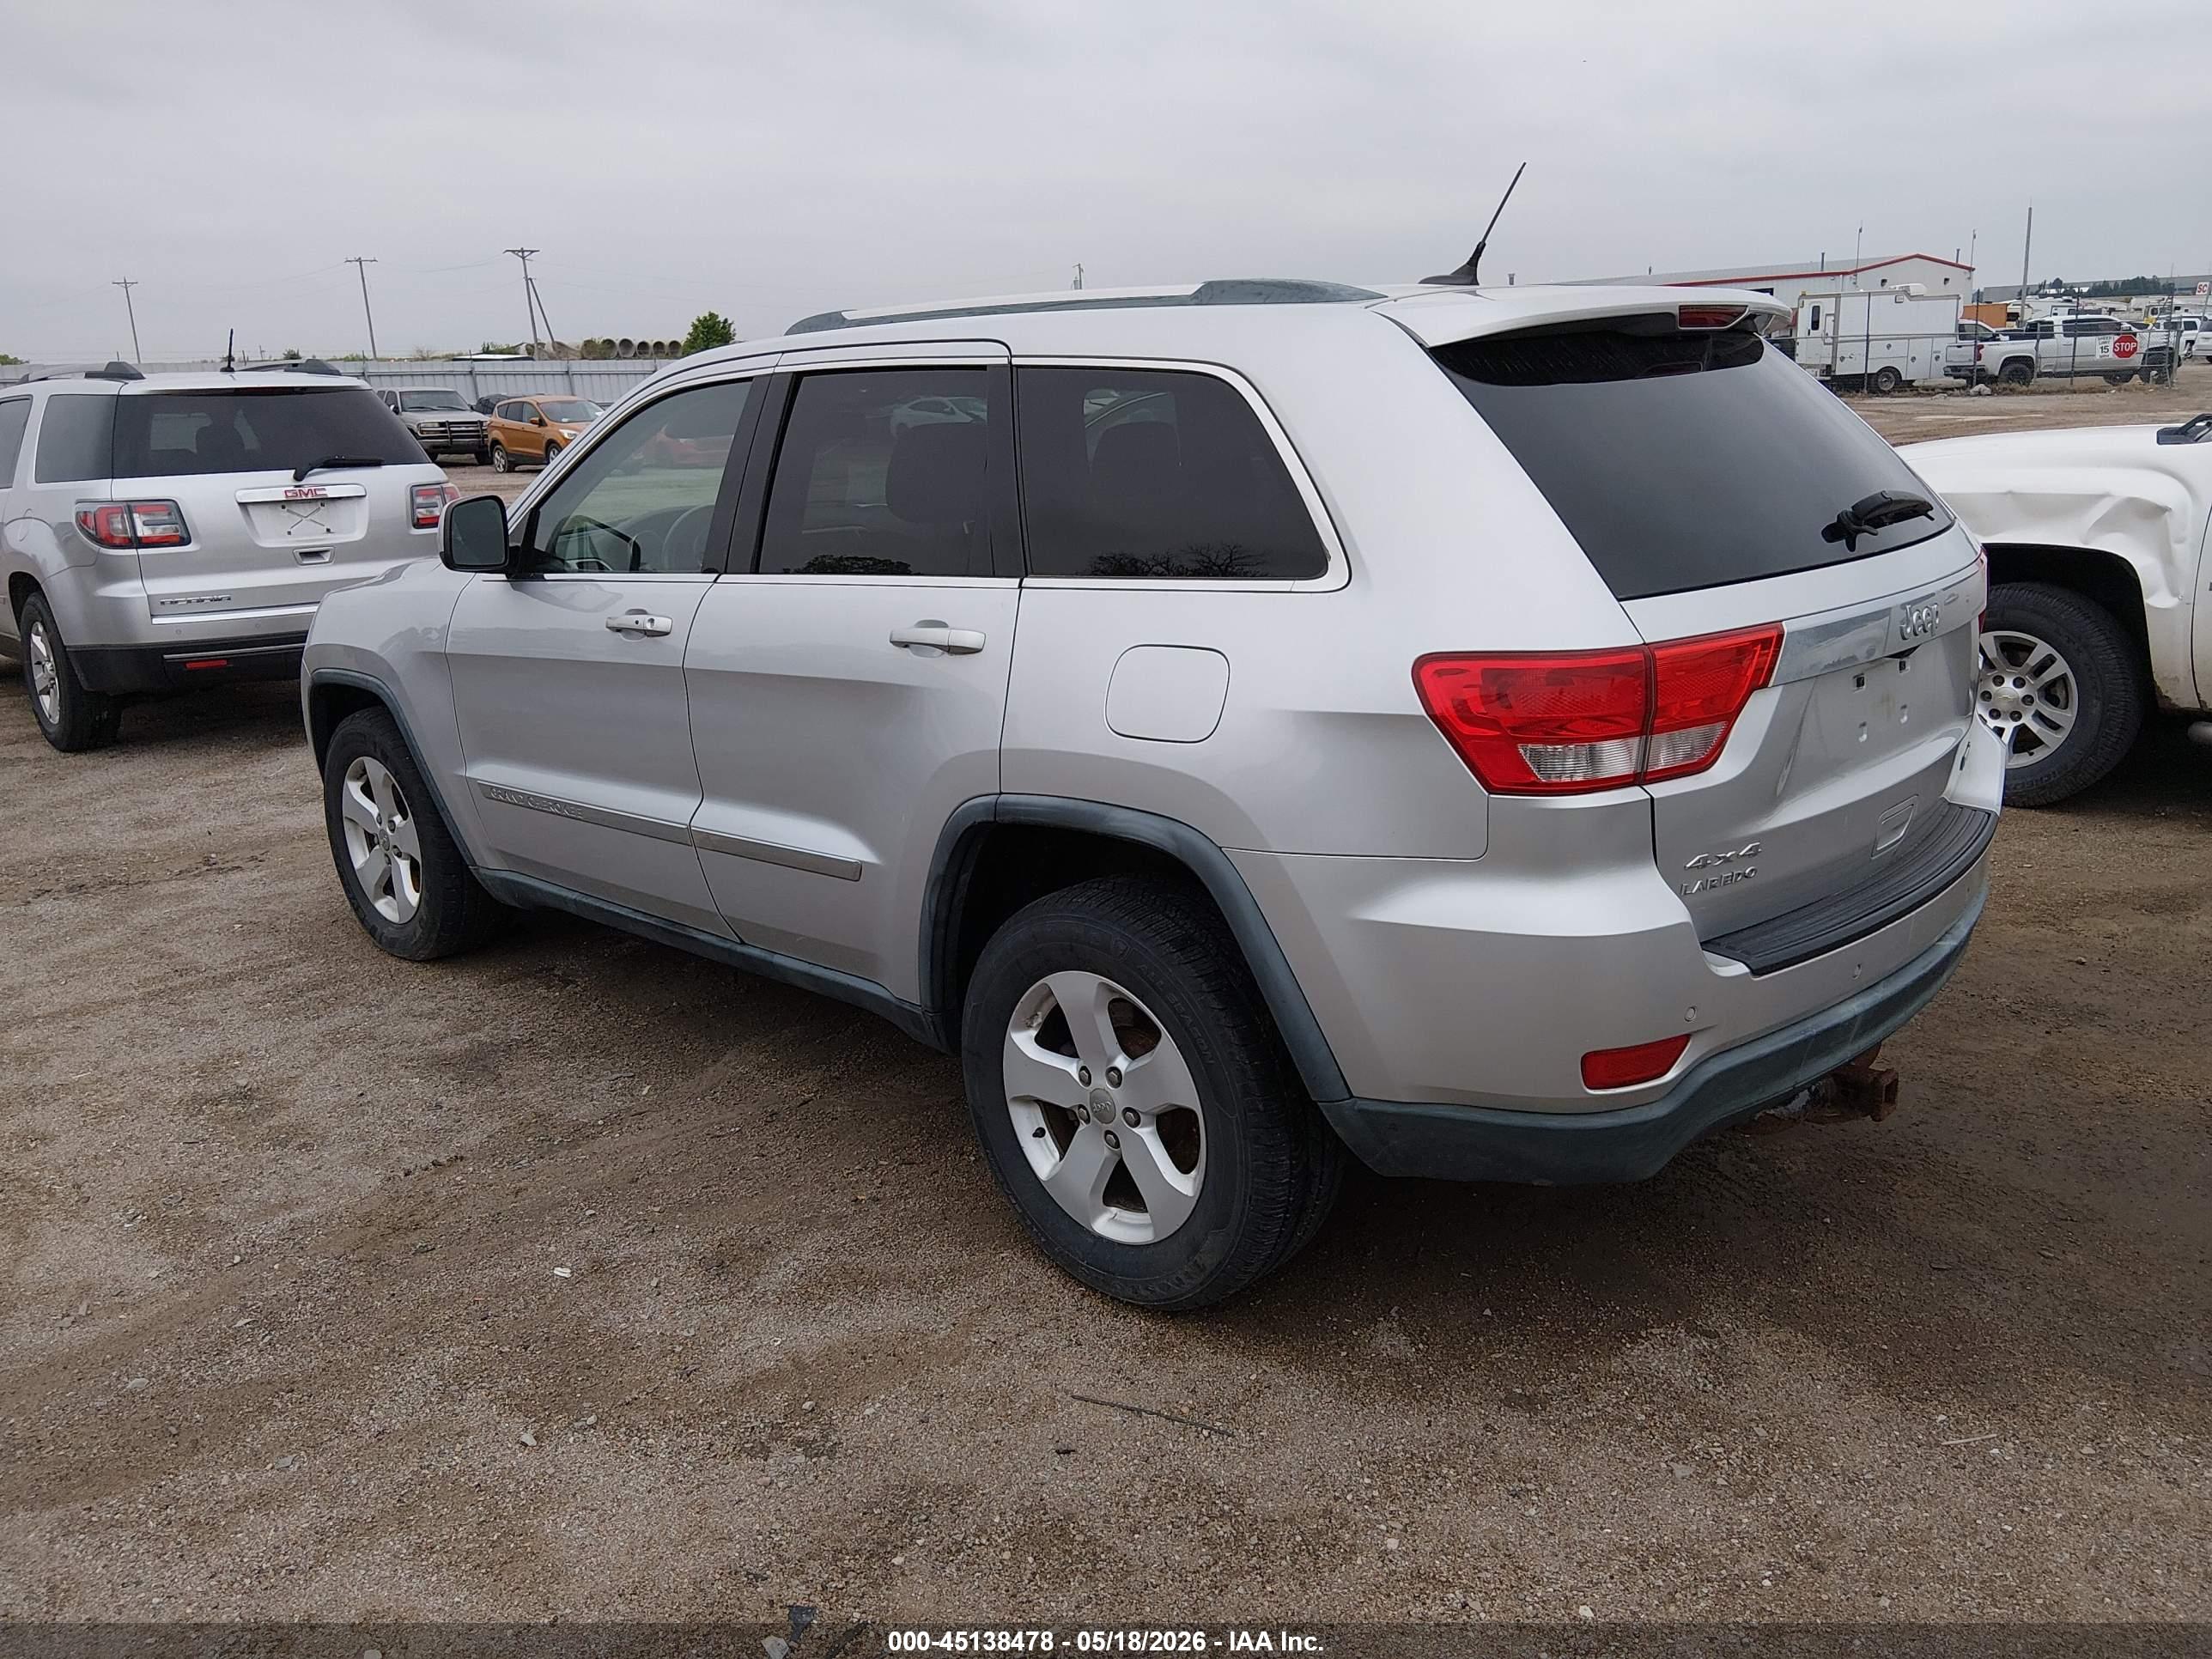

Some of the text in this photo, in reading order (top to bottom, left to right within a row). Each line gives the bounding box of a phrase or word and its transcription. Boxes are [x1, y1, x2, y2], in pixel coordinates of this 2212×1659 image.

[2100, 345, 2110, 354] 15
[2113, 342, 2137, 352] STOP
[284, 488, 328, 499] GMC
[1899, 603, 1939, 641] Jeep
[1685, 842, 1762, 869] 4x4
[1680, 866, 1758, 896] LAREDO
